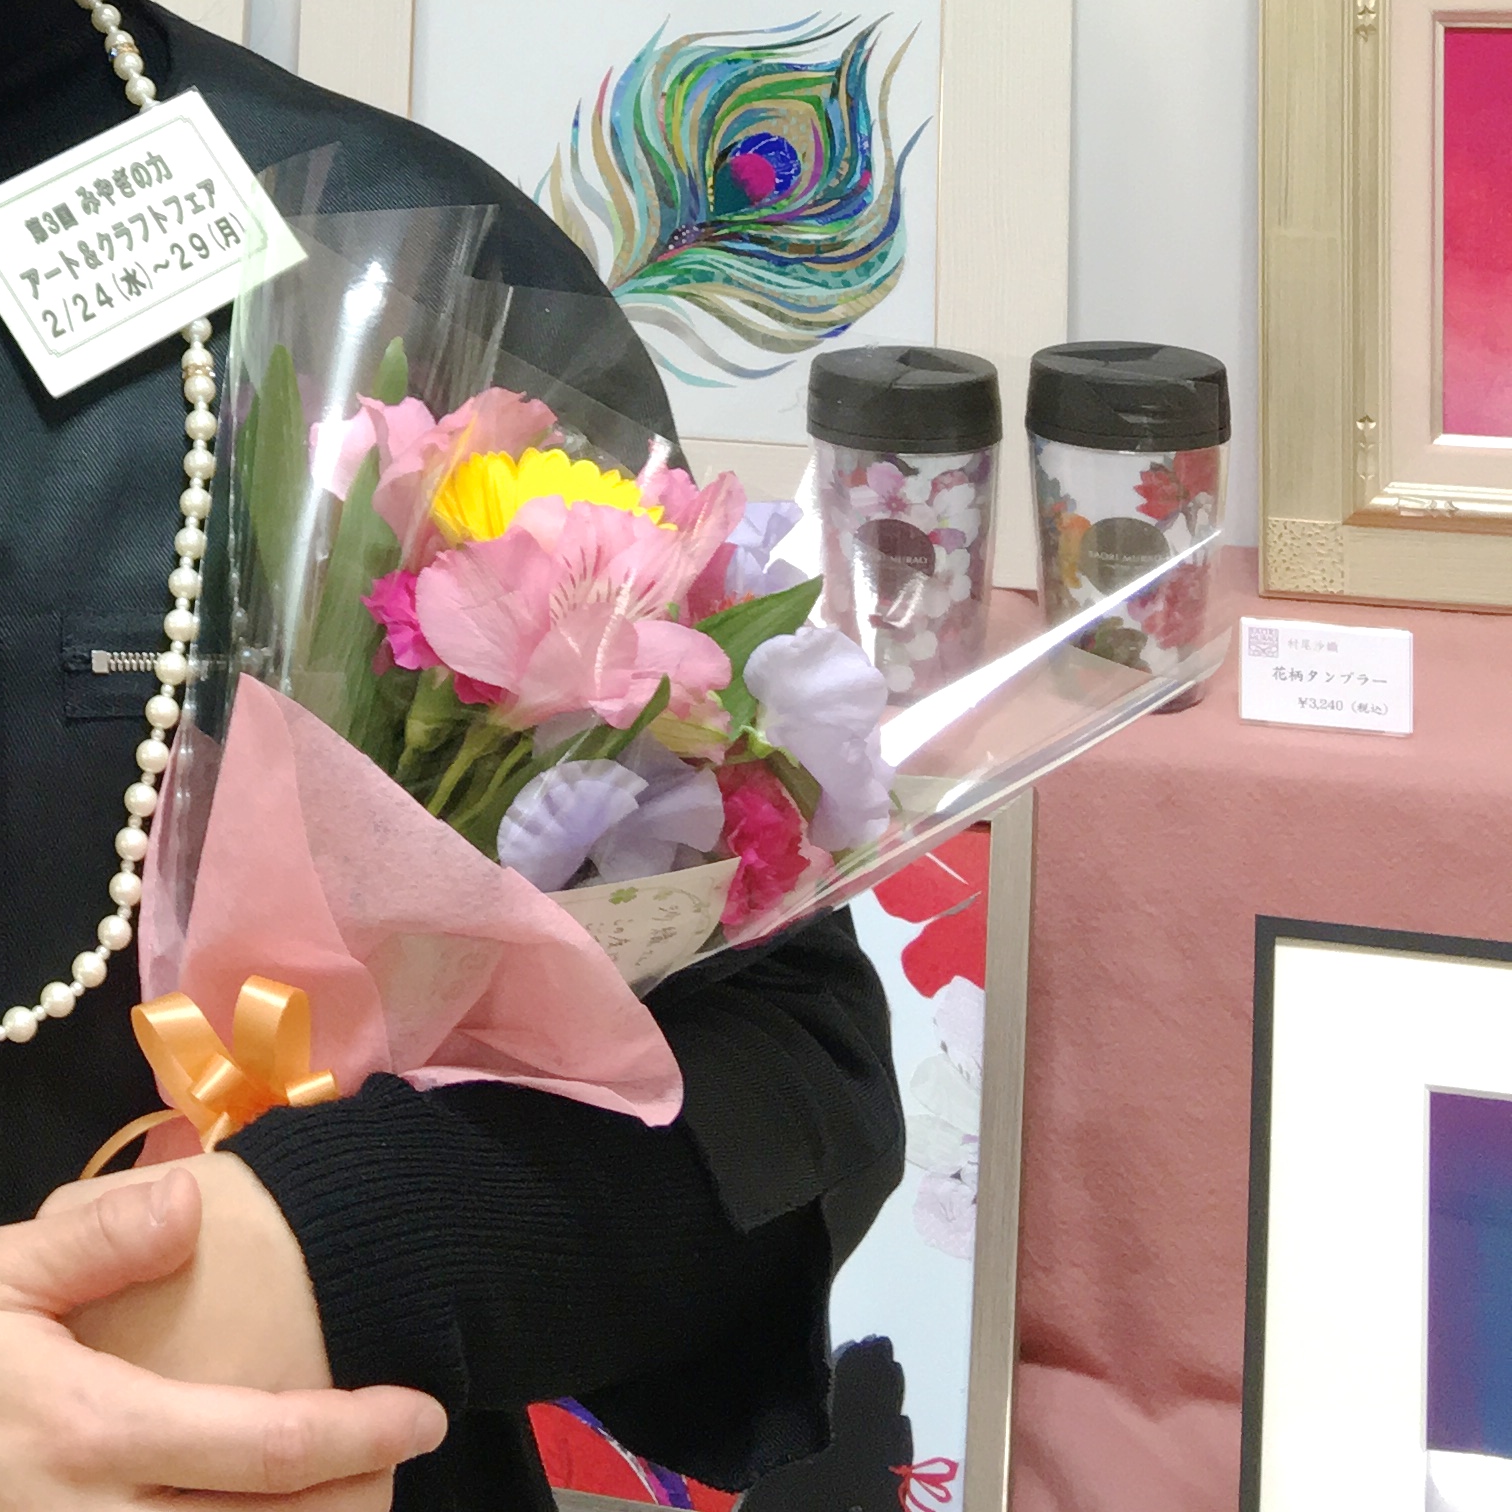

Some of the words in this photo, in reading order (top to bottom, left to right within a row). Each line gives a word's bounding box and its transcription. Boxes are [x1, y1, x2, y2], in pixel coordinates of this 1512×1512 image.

[75, 151, 173, 215] みやぎの力
[19, 178, 216, 300] アート&クラフトフェア
[1272, 665, 1388, 686] 花柄タンブラー
[1298, 696, 1344, 712] ¥3,240
